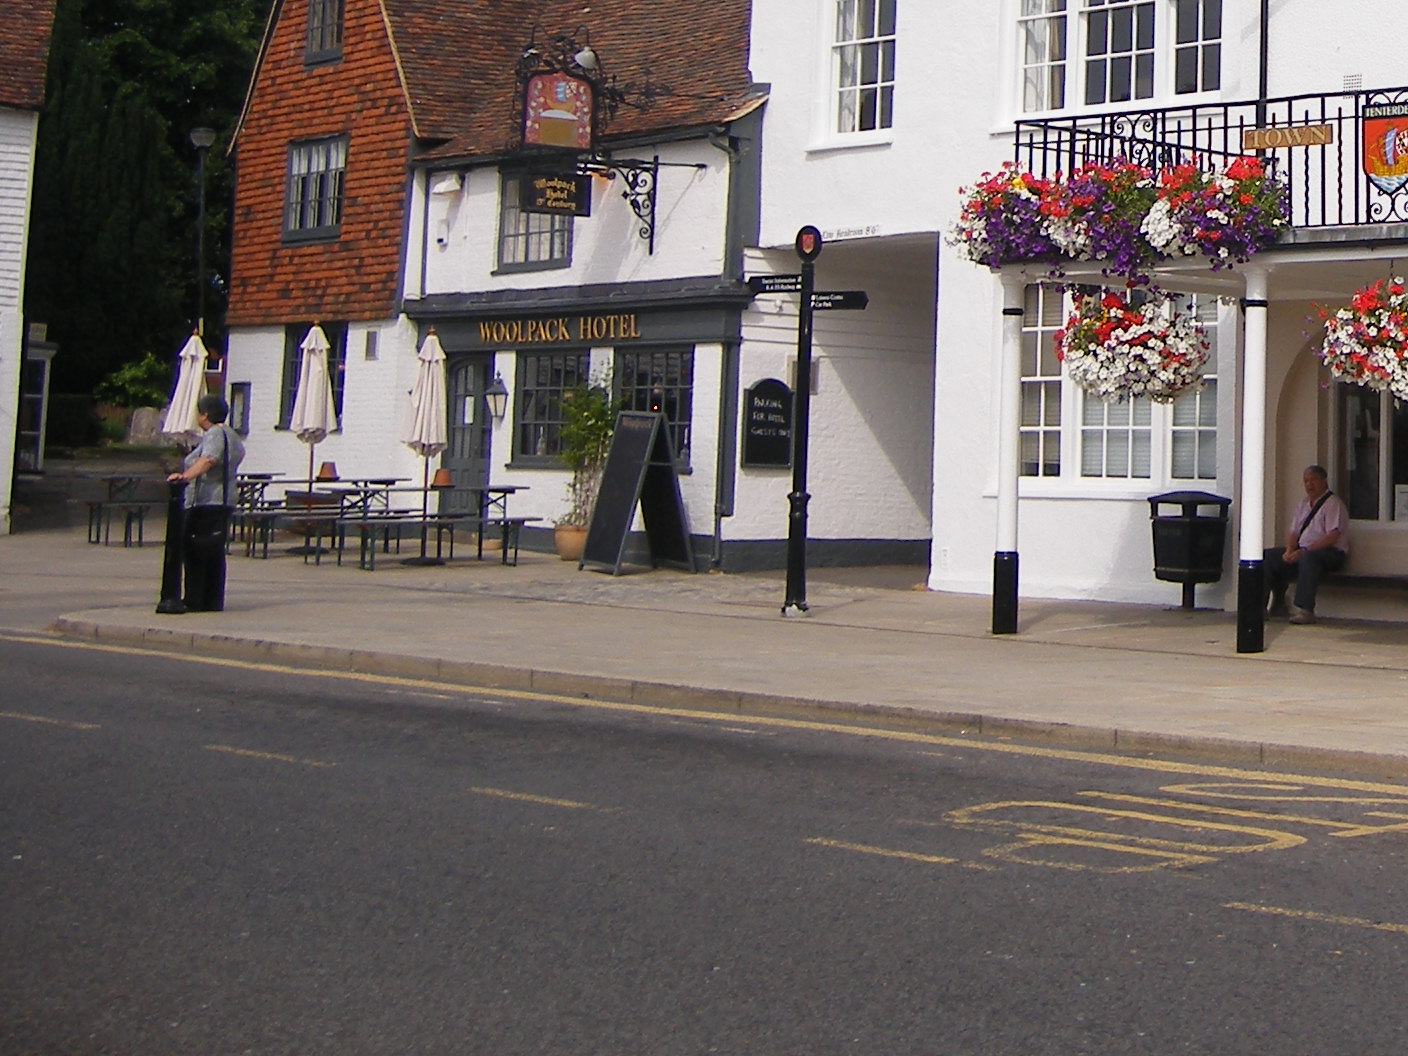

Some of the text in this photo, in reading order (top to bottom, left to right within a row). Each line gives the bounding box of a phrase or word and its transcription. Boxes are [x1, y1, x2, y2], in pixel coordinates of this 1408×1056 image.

[1247, 125, 1328, 148] TOWN
[534, 177, 576, 193] Woolpack
[479, 313, 642, 344] WOOLPACK HOTEL
[752, 411, 765, 422] FOR
